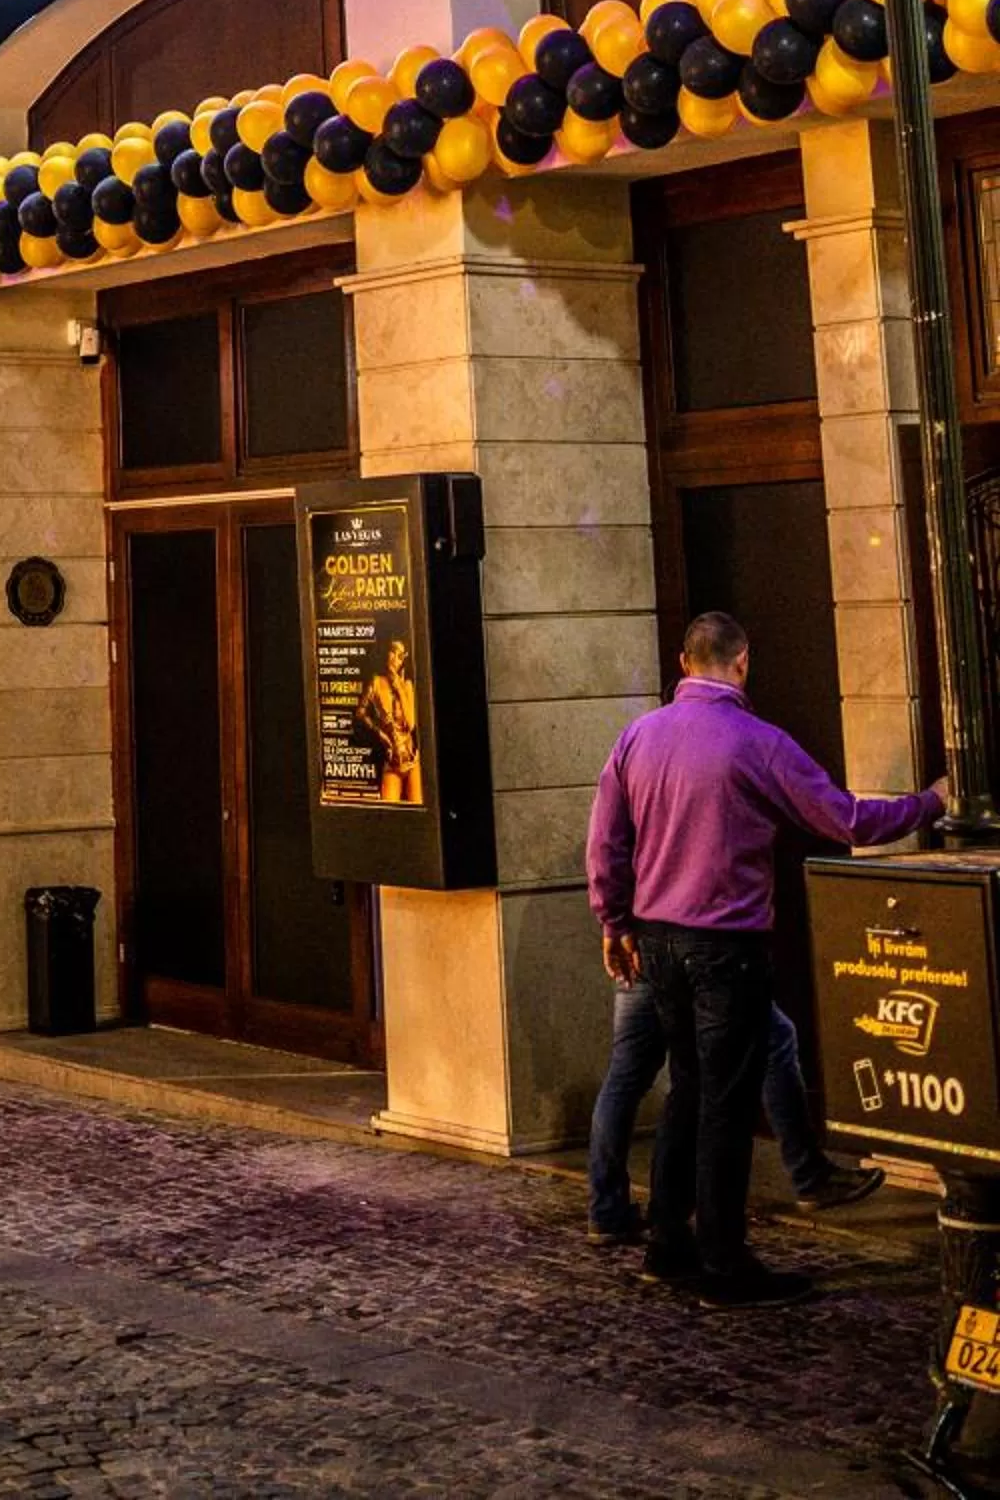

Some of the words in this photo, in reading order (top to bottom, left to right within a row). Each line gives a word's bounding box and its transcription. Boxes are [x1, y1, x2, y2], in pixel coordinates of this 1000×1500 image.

[325, 553, 393, 575] GOLDEN
[356, 576, 405, 597] PARTY
[833, 961, 897, 980] produsele
[877, 998, 924, 1026] KFC
